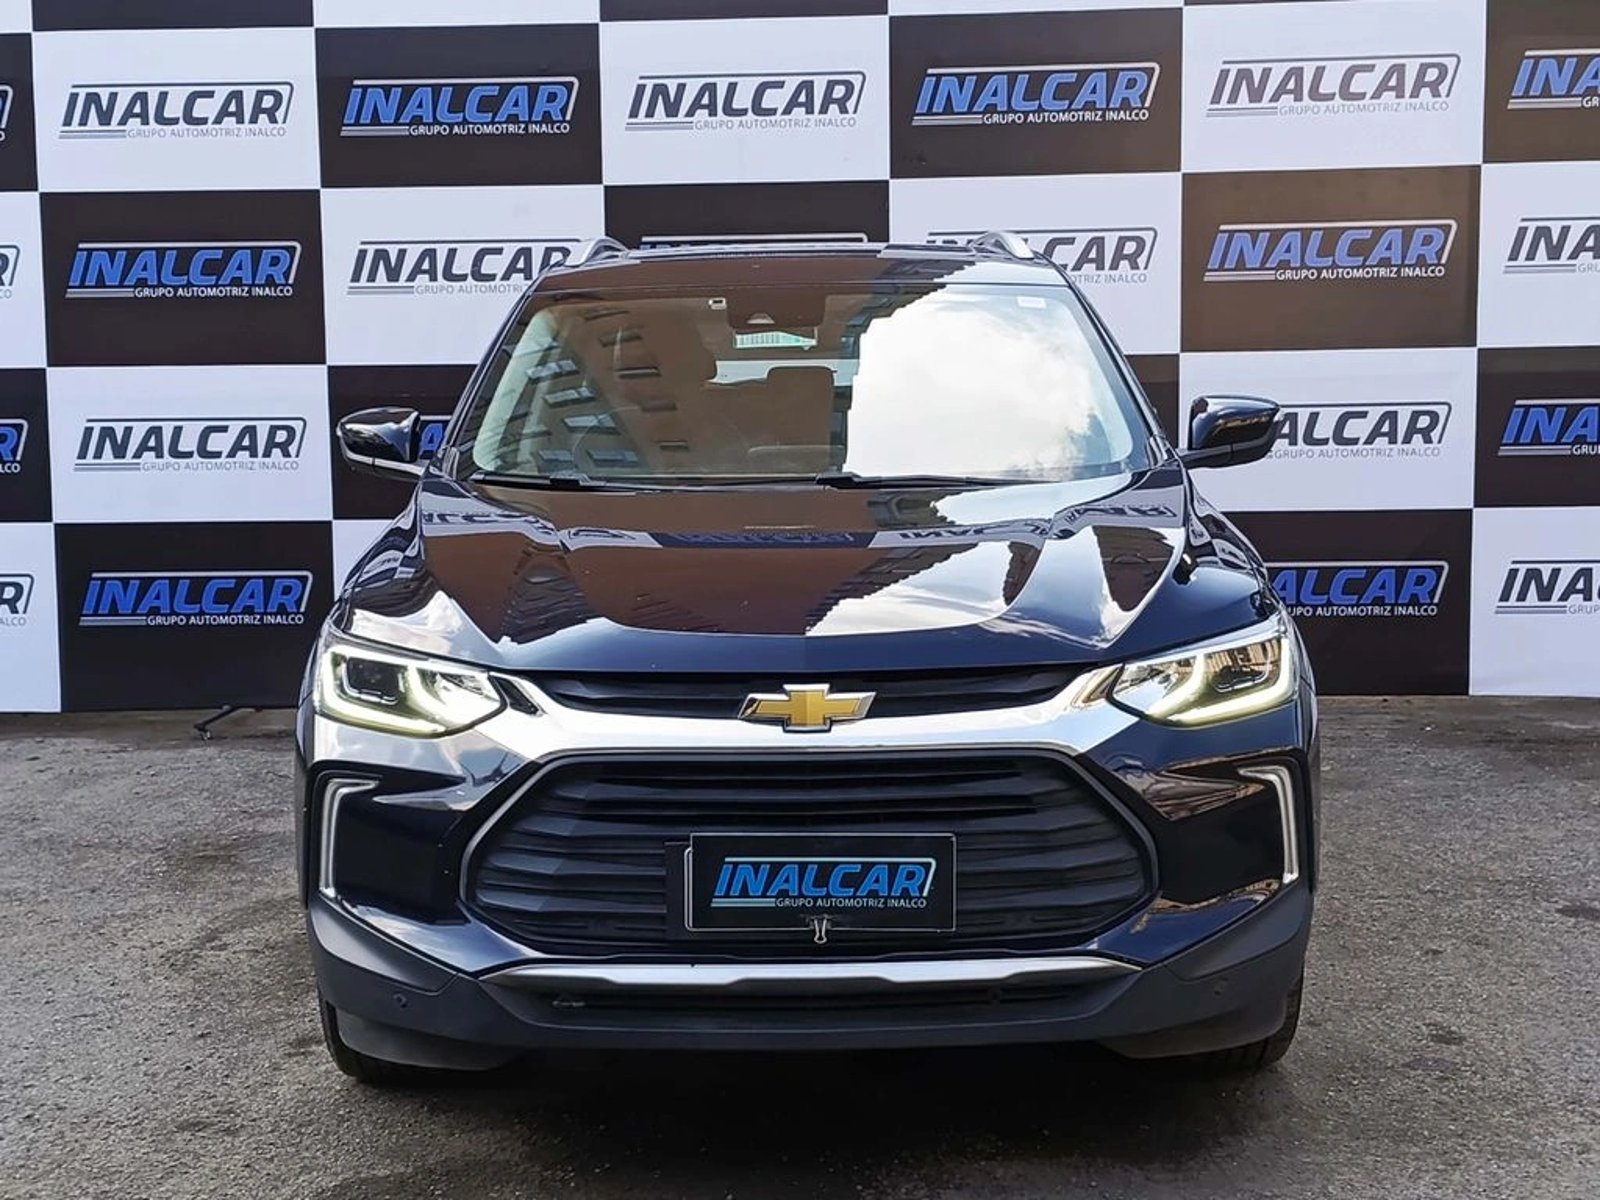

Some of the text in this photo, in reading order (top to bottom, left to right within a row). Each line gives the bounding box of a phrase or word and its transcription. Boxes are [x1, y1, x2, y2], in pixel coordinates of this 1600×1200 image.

[914, 70, 1148, 114] INALCAR
[1209, 61, 1449, 106] INALCAR
[342, 84, 569, 124] INALCAR
[627, 79, 855, 120] INALCAR
[1278, 100, 1450, 116] GRUPO AUTOMOTRIZ INALCO
[62, 90, 284, 127] INALCAR
[982, 108, 1149, 125] GRUPO AUTOMOTRIZ INALCO
[409, 122, 571, 136] GRUPO AUTOMOTRIZ INALCO
[694, 116, 857, 131] GRUPO AUTOMOTRIZ INALCO
[127, 126, 287, 139] GRUPO AUTOMOTRIZ INALCO
[1207, 227, 1446, 270] INALCAR
[67, 249, 292, 286] INALCAR
[1275, 264, 1446, 281] GRUPO AUTOMOTRIZ INALCO
[1104, 272, 1148, 284] INALCO
[134, 284, 294, 298] GRUPO AUTOMOTRIZ INALCO
[415, 284, 455, 295] GRUPO
[1270, 409, 1441, 446] ALCAR
[76, 424, 297, 460] INALCAR
[1274, 446, 1441, 460] GRUPO AUTOMOTRIZ INALCO
[142, 459, 300, 472] GRUPO AUTOMOTRIZ INALCO
[1272, 568, 1438, 605] ALCAR
[1497, 567, 1600, 603] INA
[82, 577, 303, 615] INALCAR
[1315, 605, 1392, 617] AUTOMOTRIZ
[1394, 604, 1438, 616] INALCO
[146, 613, 305, 626] GRUPO AUTOMOTRIZ INALCO
[713, 863, 926, 897] INALCAR
[776, 897, 928, 910] GRUPO AUTOMOTRIZ INALCO
